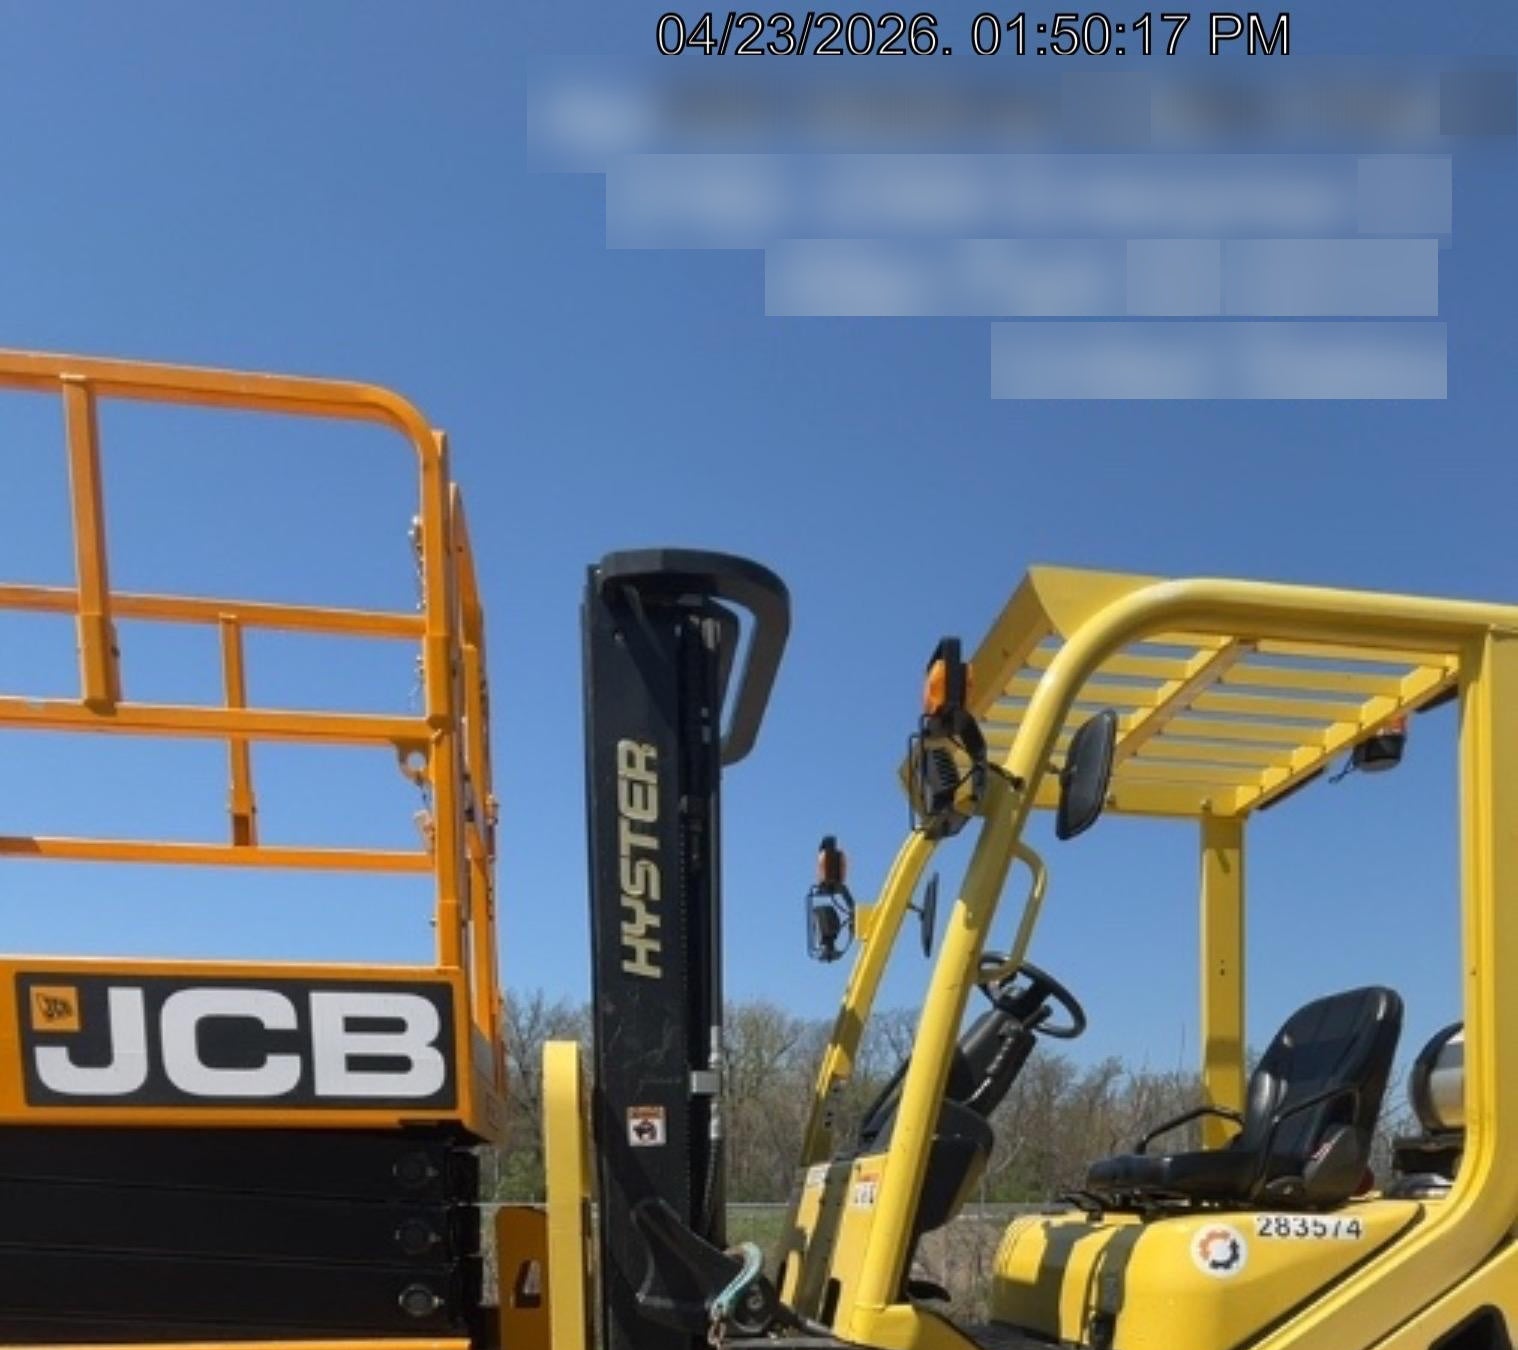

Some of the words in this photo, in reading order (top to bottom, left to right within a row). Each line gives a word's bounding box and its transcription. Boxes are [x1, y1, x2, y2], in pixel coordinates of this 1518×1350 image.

[617, 738, 662, 978] HYSTER
[34, 986, 446, 1096] JCB
[1257, 1216, 1362, 1240] 283574
